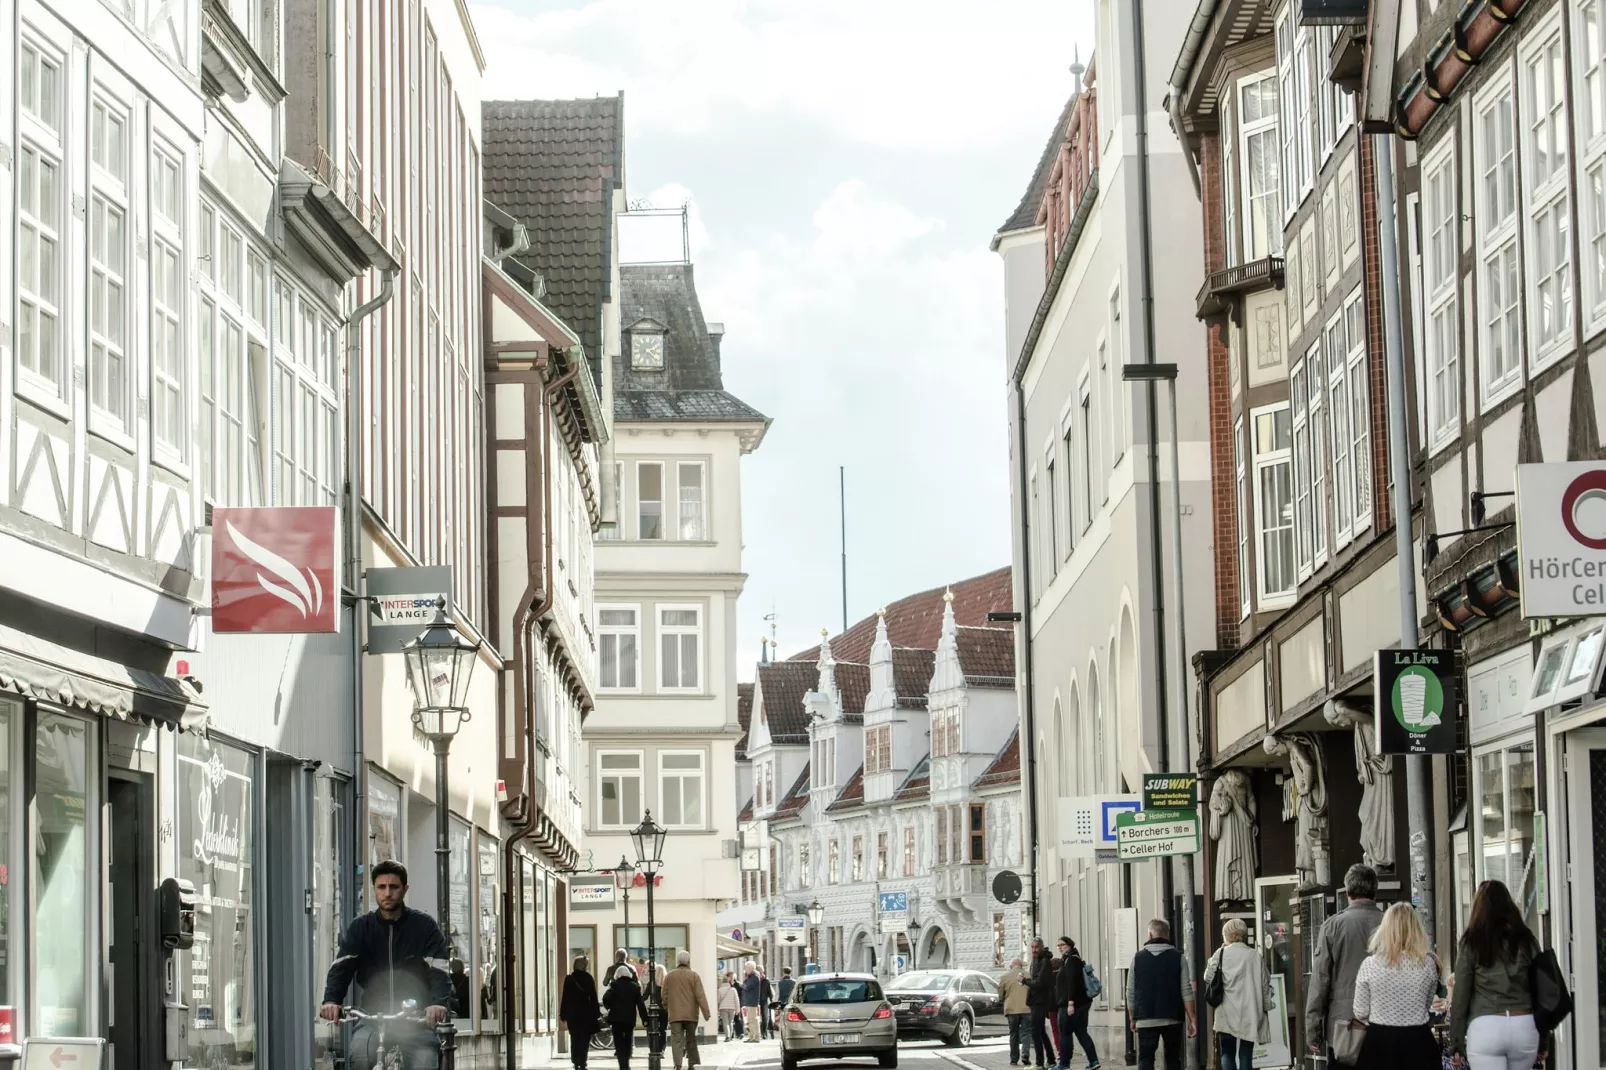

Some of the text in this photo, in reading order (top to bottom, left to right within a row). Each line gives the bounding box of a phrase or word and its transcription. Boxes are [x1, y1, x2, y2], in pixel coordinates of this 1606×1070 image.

[390, 610, 428, 619] LANGE
[1394, 652, 1440, 664] La Liva
[1145, 778, 1196, 791] SUBWAY
[1149, 811, 1180, 820] Hotelroute
[1128, 828, 1170, 838] Borchers
[1173, 826, 1183, 834] 100
[1129, 842, 1174, 855] Celler Hof
